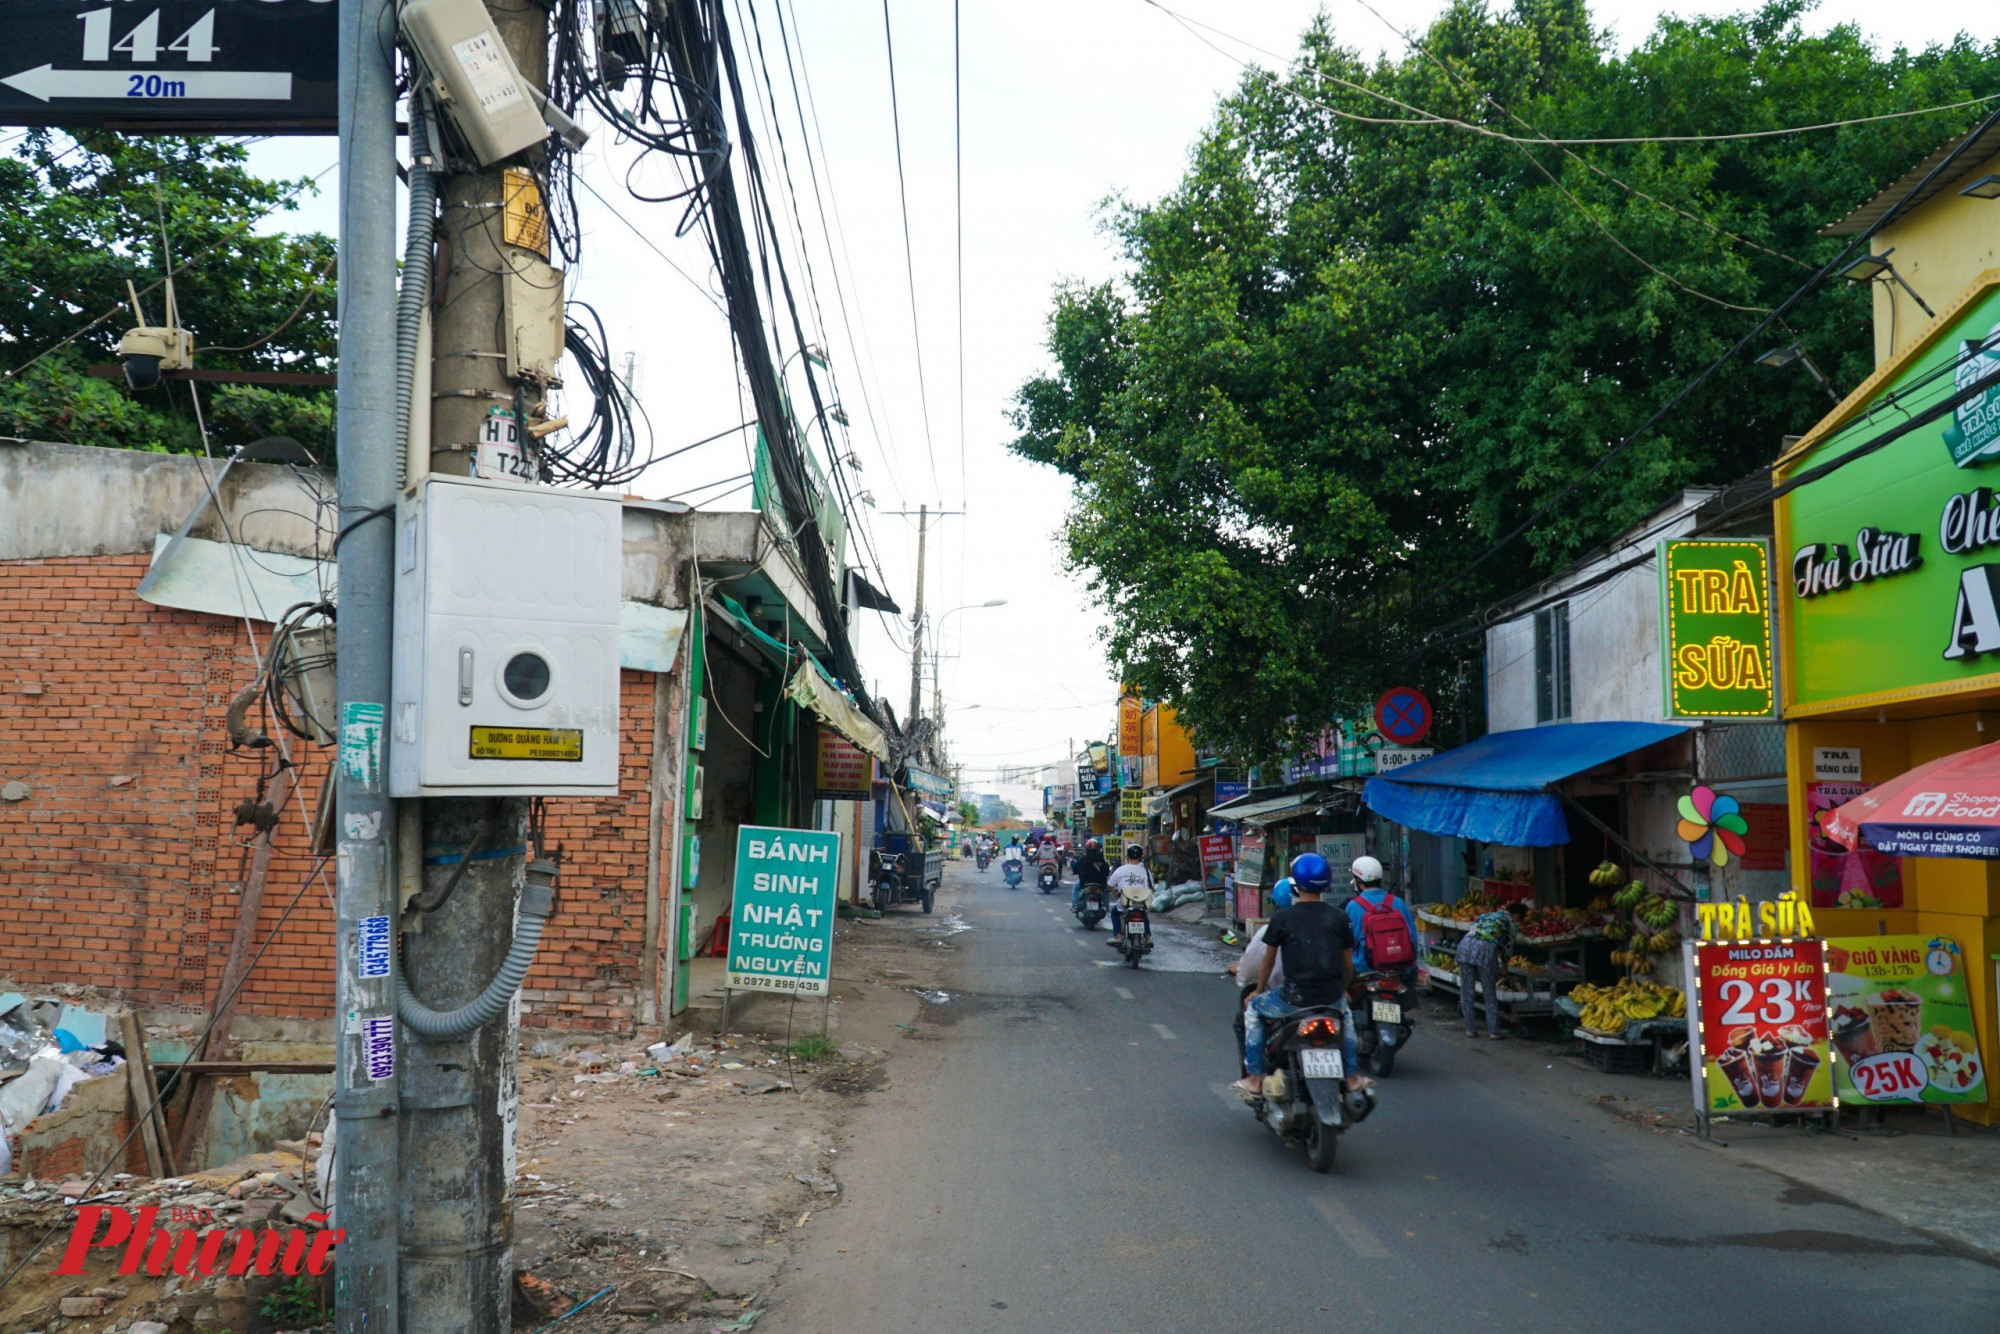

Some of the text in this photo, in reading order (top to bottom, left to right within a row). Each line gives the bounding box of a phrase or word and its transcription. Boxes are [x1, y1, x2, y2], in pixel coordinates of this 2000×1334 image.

[76, 7, 221, 62] 144
[127, 74, 186, 98] 20m
[1961, 407, 1986, 436] TRÀ
[1792, 527, 1913, 598] Trà Sữa
[1676, 560, 1760, 614] TRÀ
[1678, 636, 1766, 690] SỮA
[1939, 803, 2000, 818] Food
[1896, 829, 1981, 843] MÓN GÌ CŨNG CÓ
[748, 835, 828, 864] BÁNH
[1878, 840, 1999, 856] ĐẶT NGAY TRÊN SHOPEE!
[753, 872, 819, 895] SINH
[743, 903, 823, 931] NHẬT
[1696, 889, 1817, 941] TRÀ SỮA
[738, 931, 823, 953] TRƯỞNG
[735, 954, 821, 976] NGUYỄN
[1728, 949, 1762, 960] MILO
[1852, 947, 1877, 965] GIỜ
[1881, 946, 1921, 964] VÀNG
[1750, 963, 1775, 976] Giá
[1778, 962, 1790, 978] ly
[1793, 962, 1815, 974] lớn
[1864, 965, 1914, 977] 13h-17h
[743, 976, 820, 991] 0972 296 435
[1856, 1057, 1922, 1097] 25K
